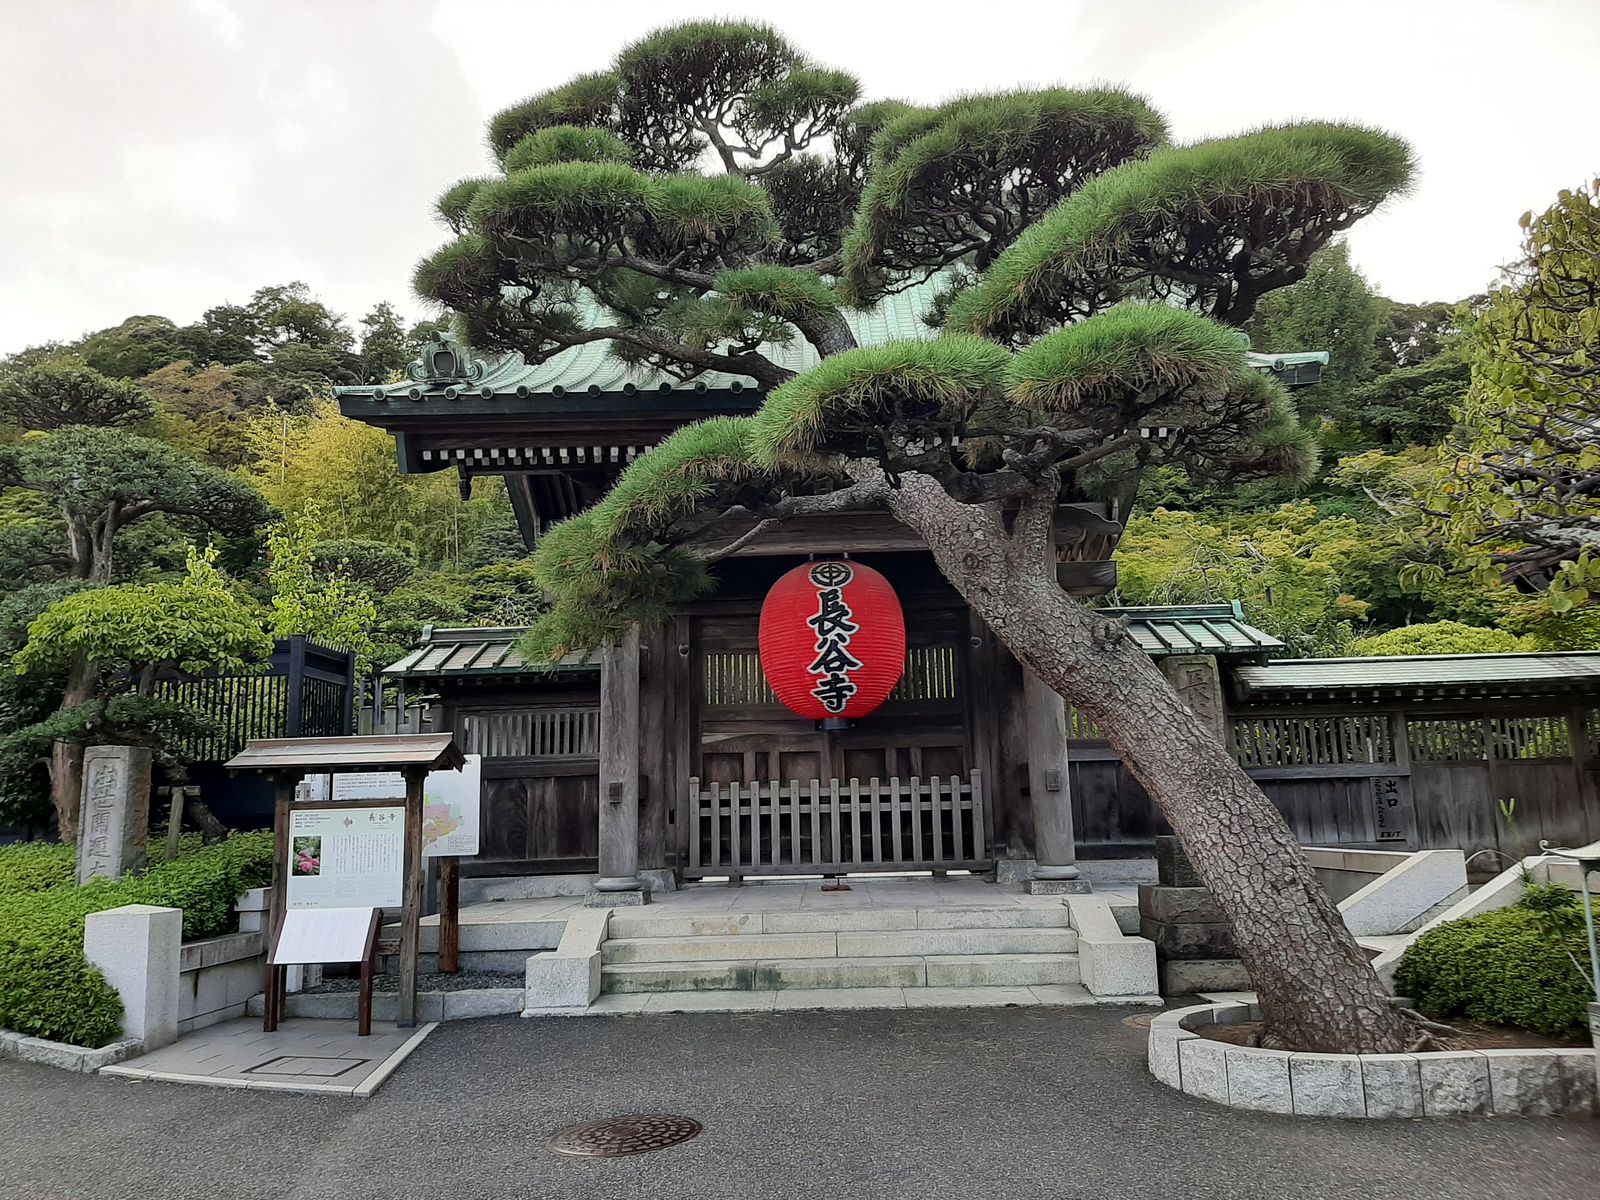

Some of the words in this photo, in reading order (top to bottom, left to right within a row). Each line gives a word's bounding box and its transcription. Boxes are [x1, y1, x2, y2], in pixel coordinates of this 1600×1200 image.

[807, 587, 863, 713] 長谷寺
[1385, 780, 1398, 808] 出口
[367, 811, 396, 821] 長谷寺
